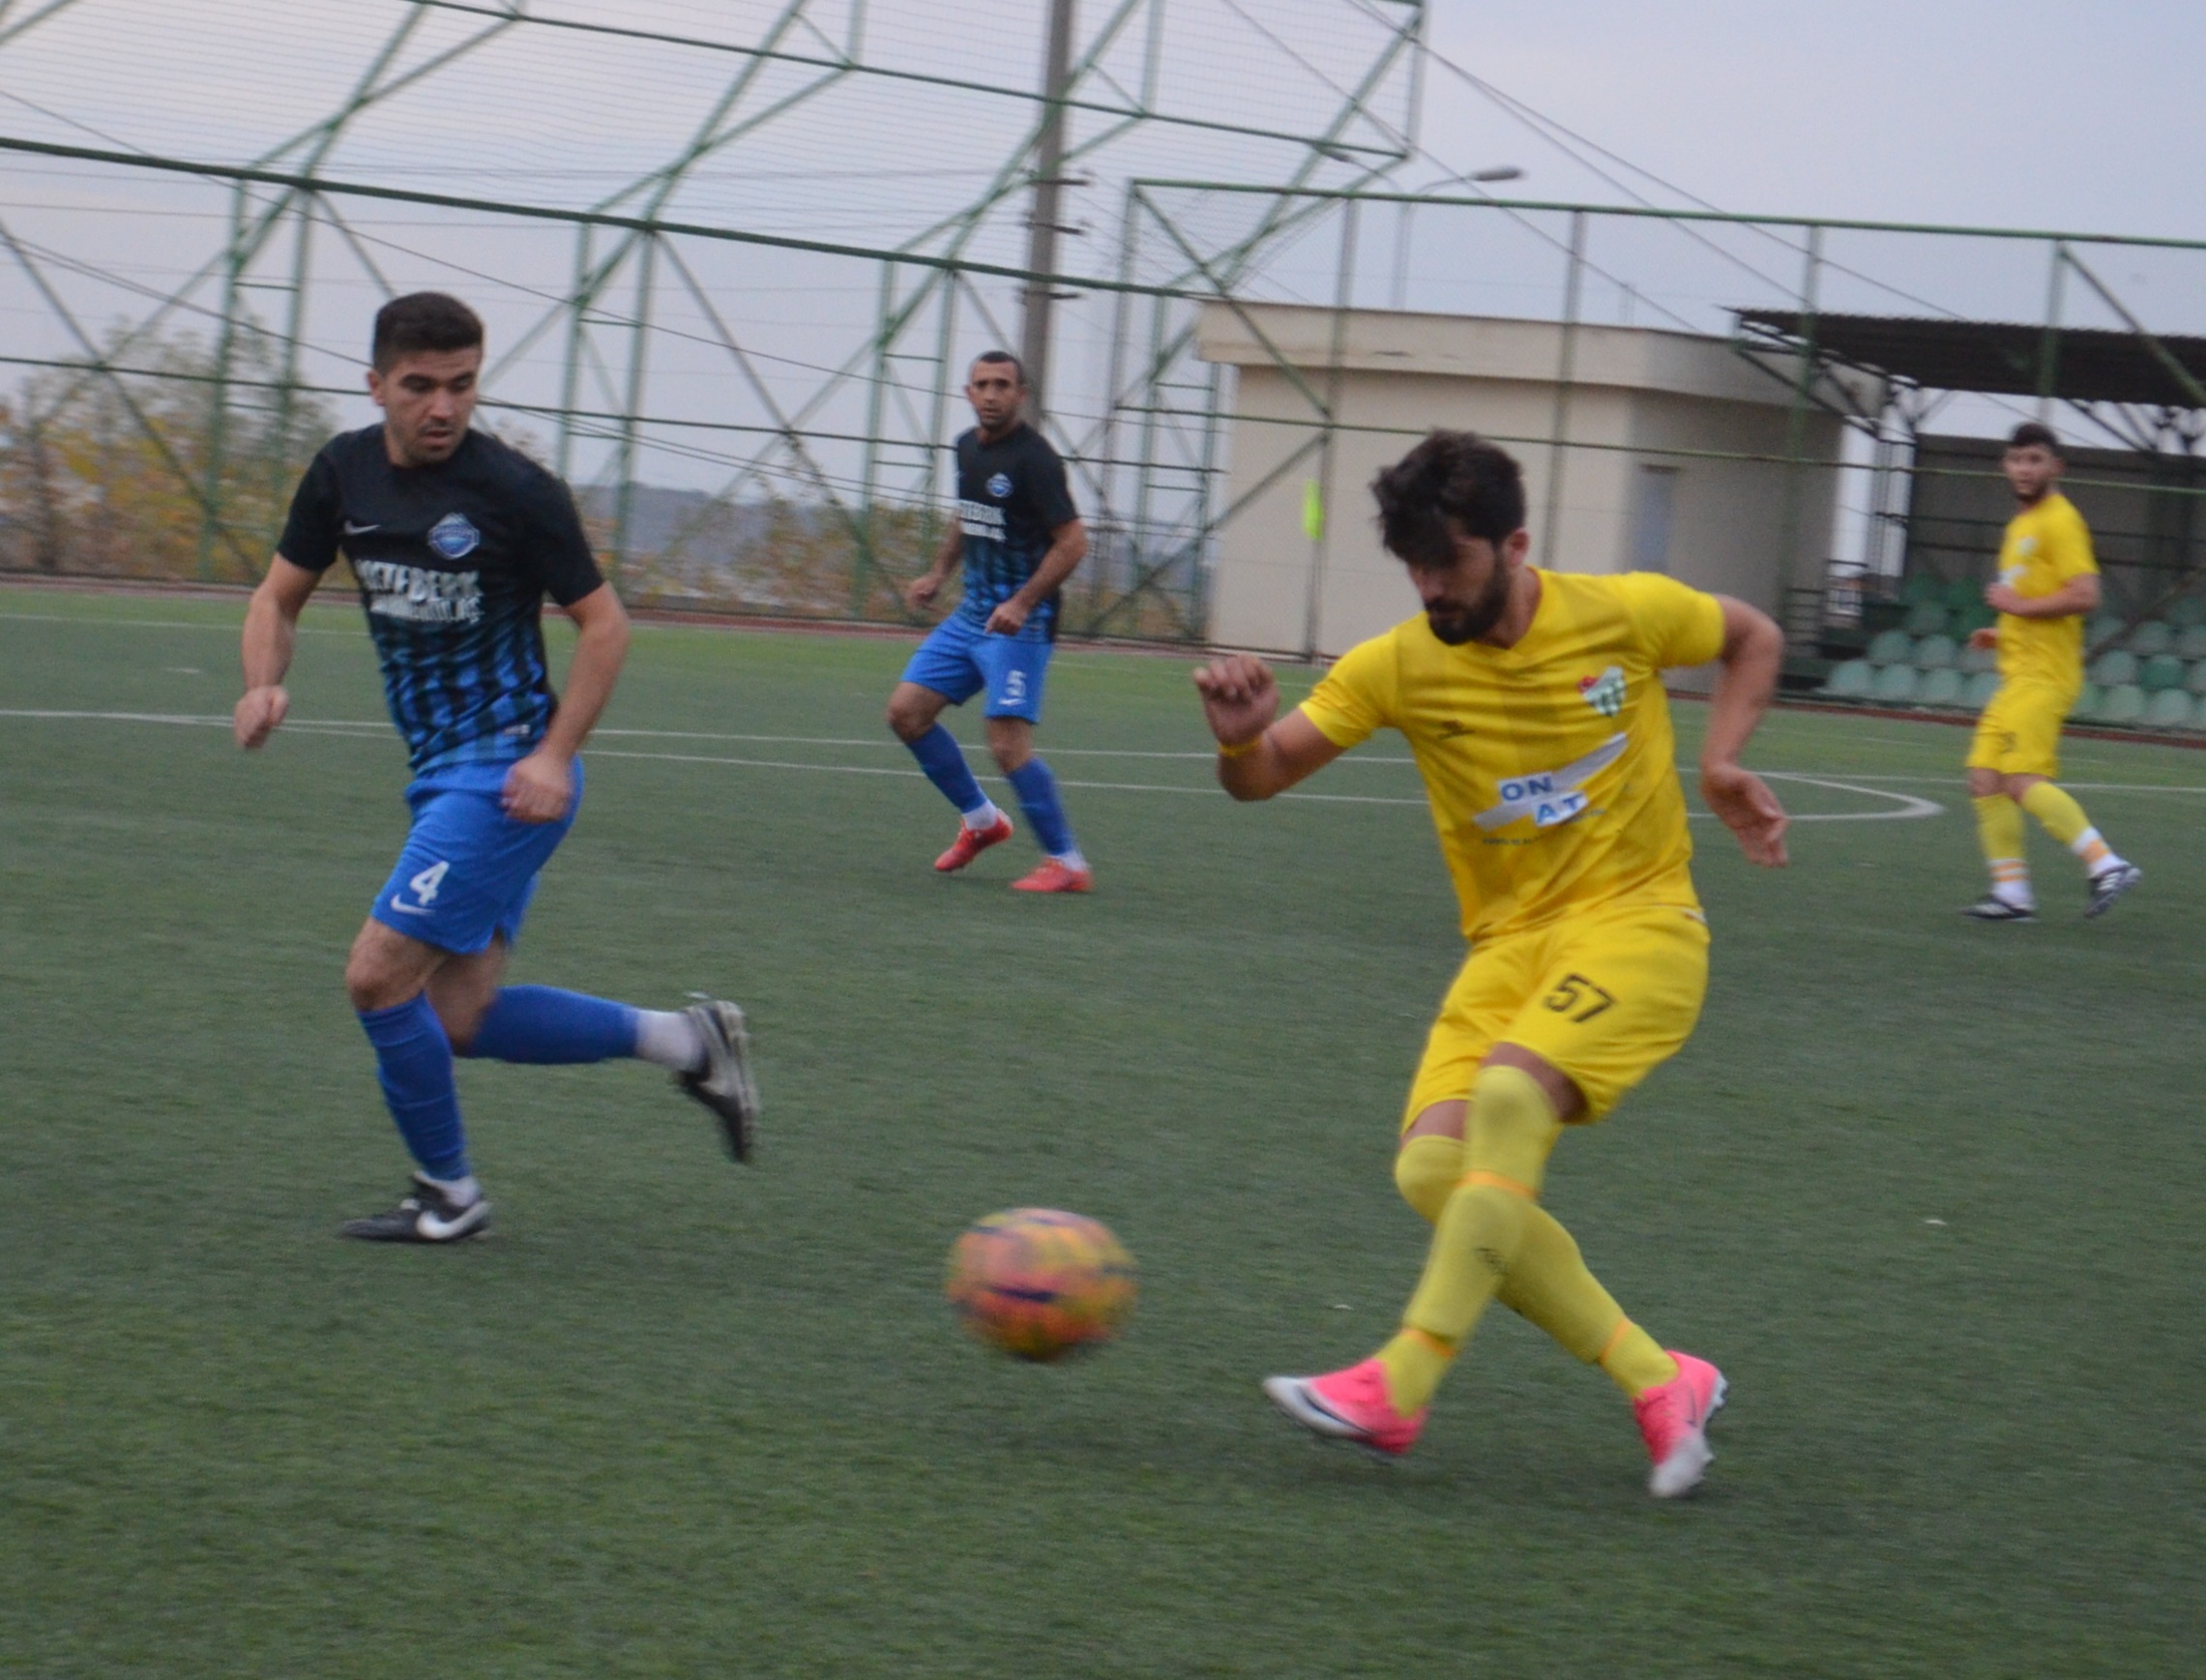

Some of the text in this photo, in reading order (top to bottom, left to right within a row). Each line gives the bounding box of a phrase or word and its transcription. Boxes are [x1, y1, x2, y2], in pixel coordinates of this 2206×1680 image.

[1006, 669, 1026, 697] 5
[1501, 776, 1552, 801] ON
[1537, 794, 1583, 824] AT
[410, 860, 450, 906] 4
[1543, 973, 1618, 1023] 57
